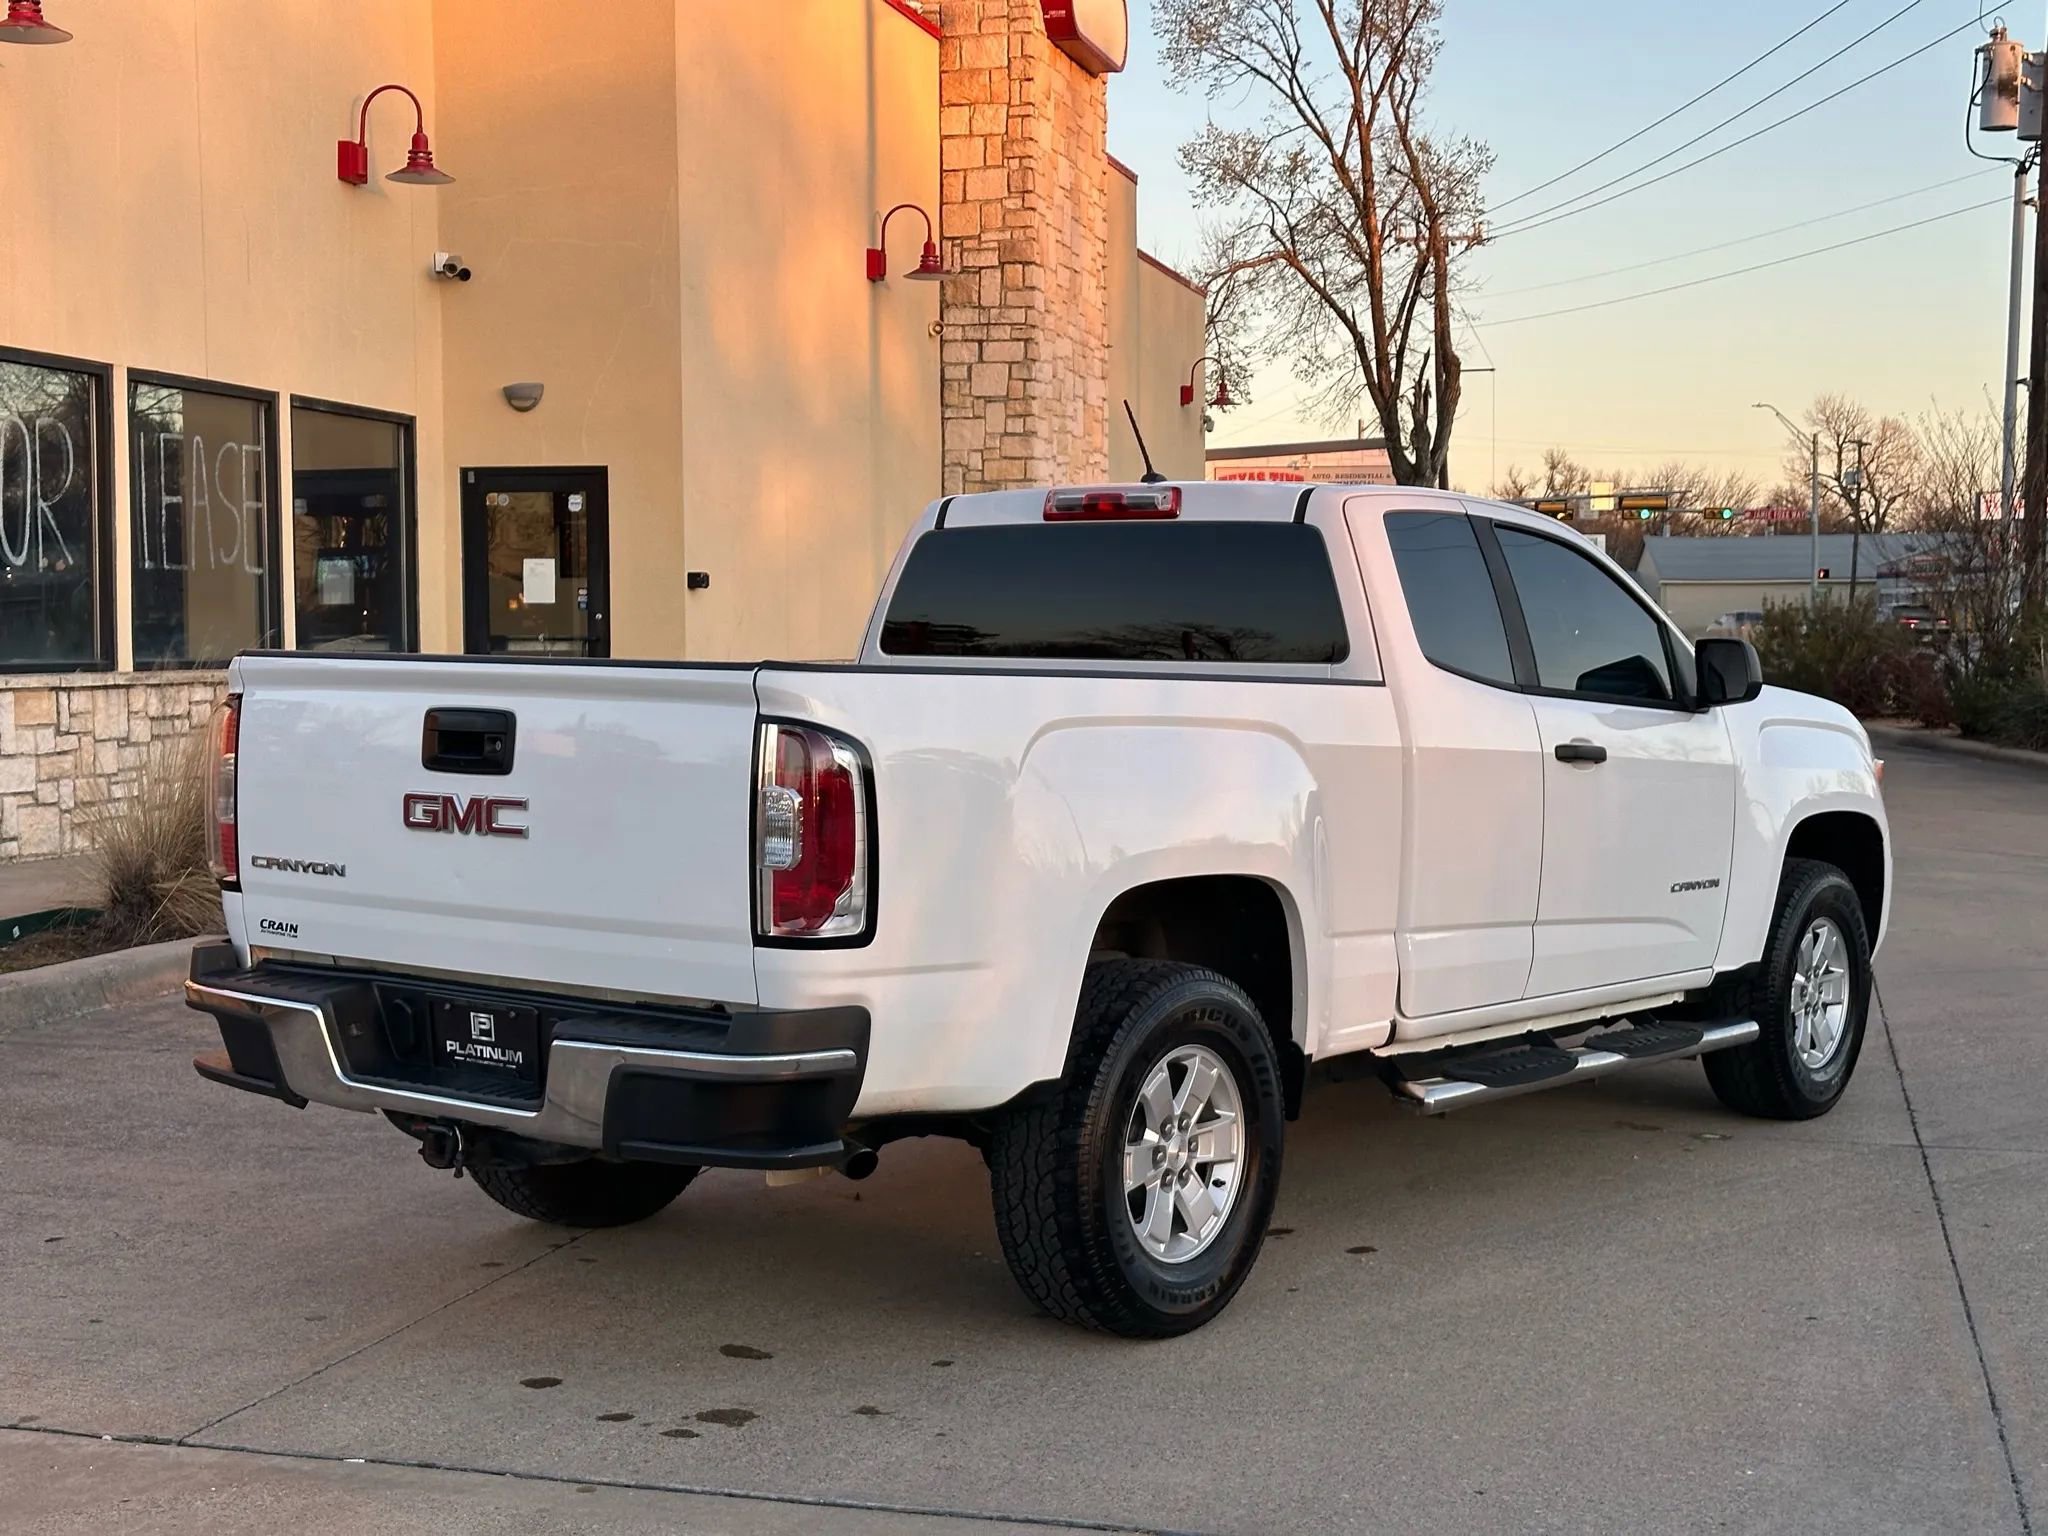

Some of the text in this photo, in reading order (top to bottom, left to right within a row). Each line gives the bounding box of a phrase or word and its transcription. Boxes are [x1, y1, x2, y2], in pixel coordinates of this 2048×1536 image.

[137, 431, 264, 576] LEASE
[402, 790, 529, 840] GMC
[251, 855, 346, 877] CANYON
[1670, 878, 1720, 893] CANYON
[260, 918, 299, 934] CRAIN
[446, 1040, 523, 1064] PLATINUM
